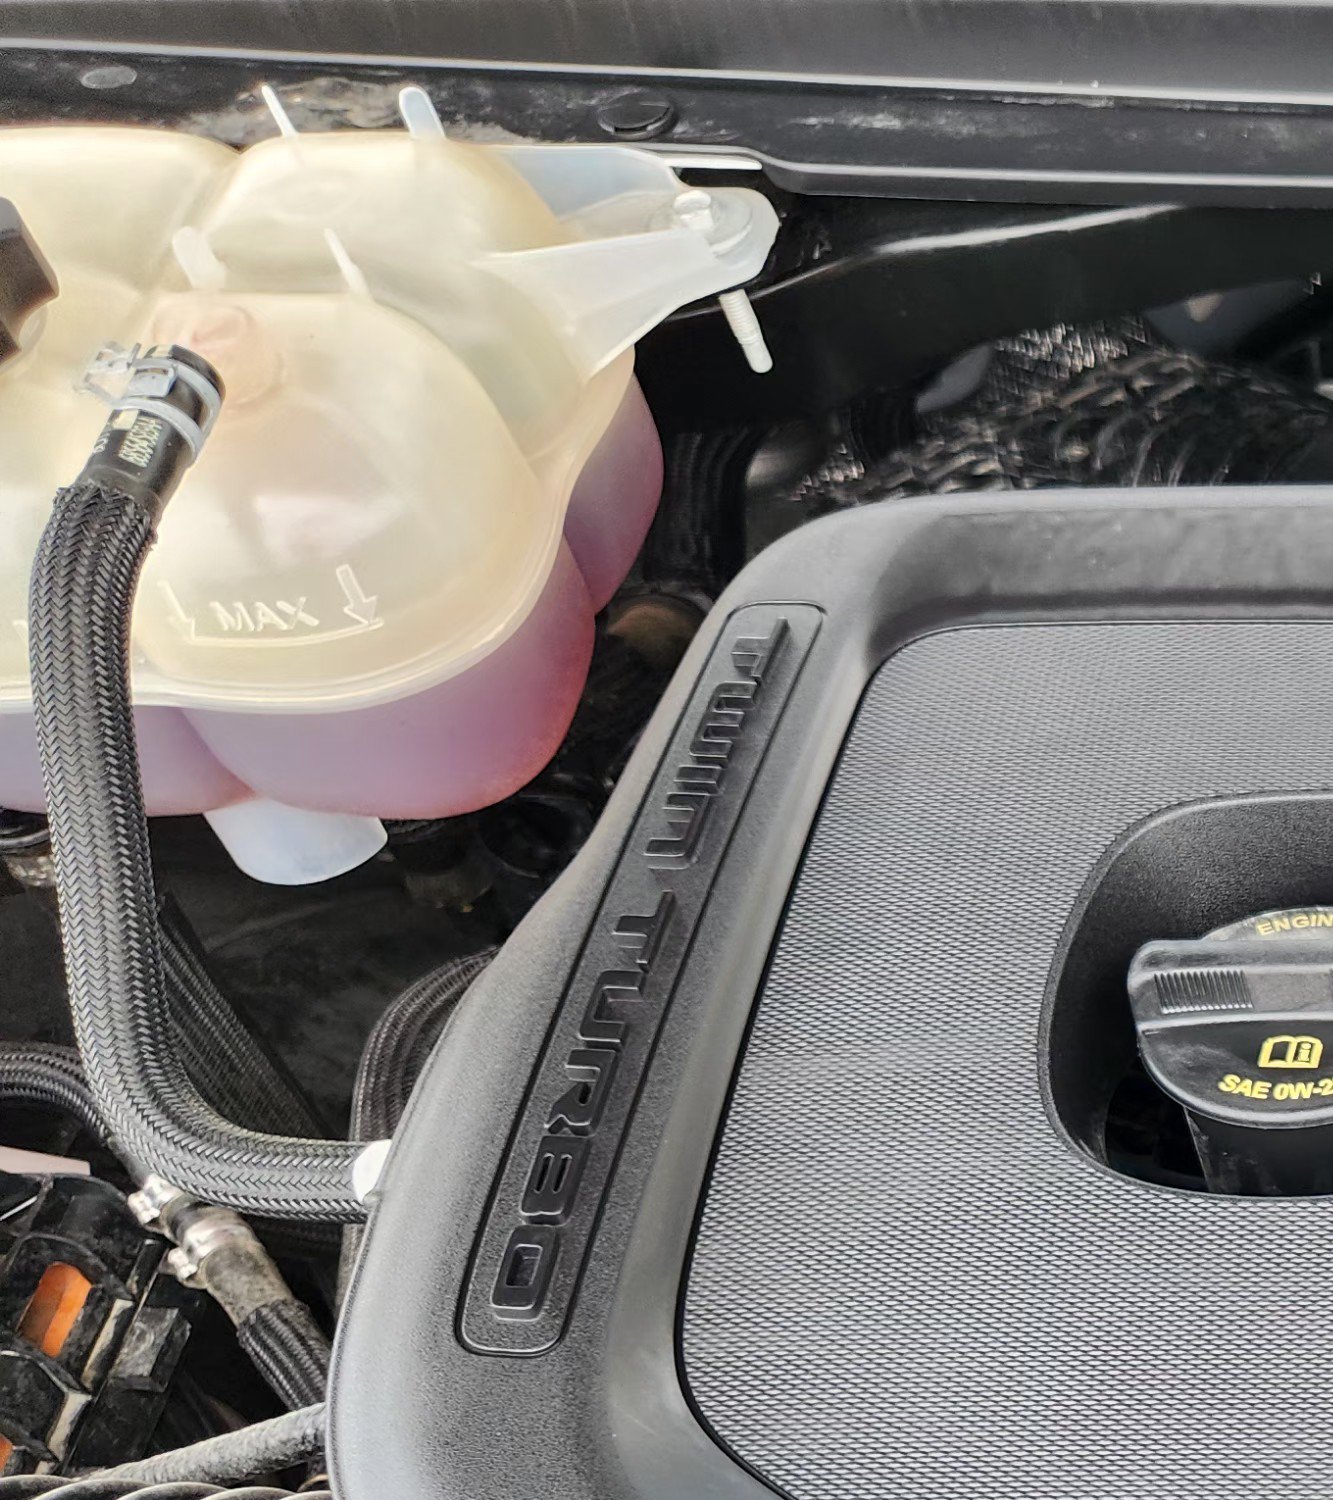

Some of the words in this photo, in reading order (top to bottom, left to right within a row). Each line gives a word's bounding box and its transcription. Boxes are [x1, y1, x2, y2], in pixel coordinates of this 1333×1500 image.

[209, 597, 320, 632] MAX
[641, 616, 790, 872] TWIN
[490, 889, 679, 1322] TURBO
[1218, 1073, 1270, 1100] SAE
